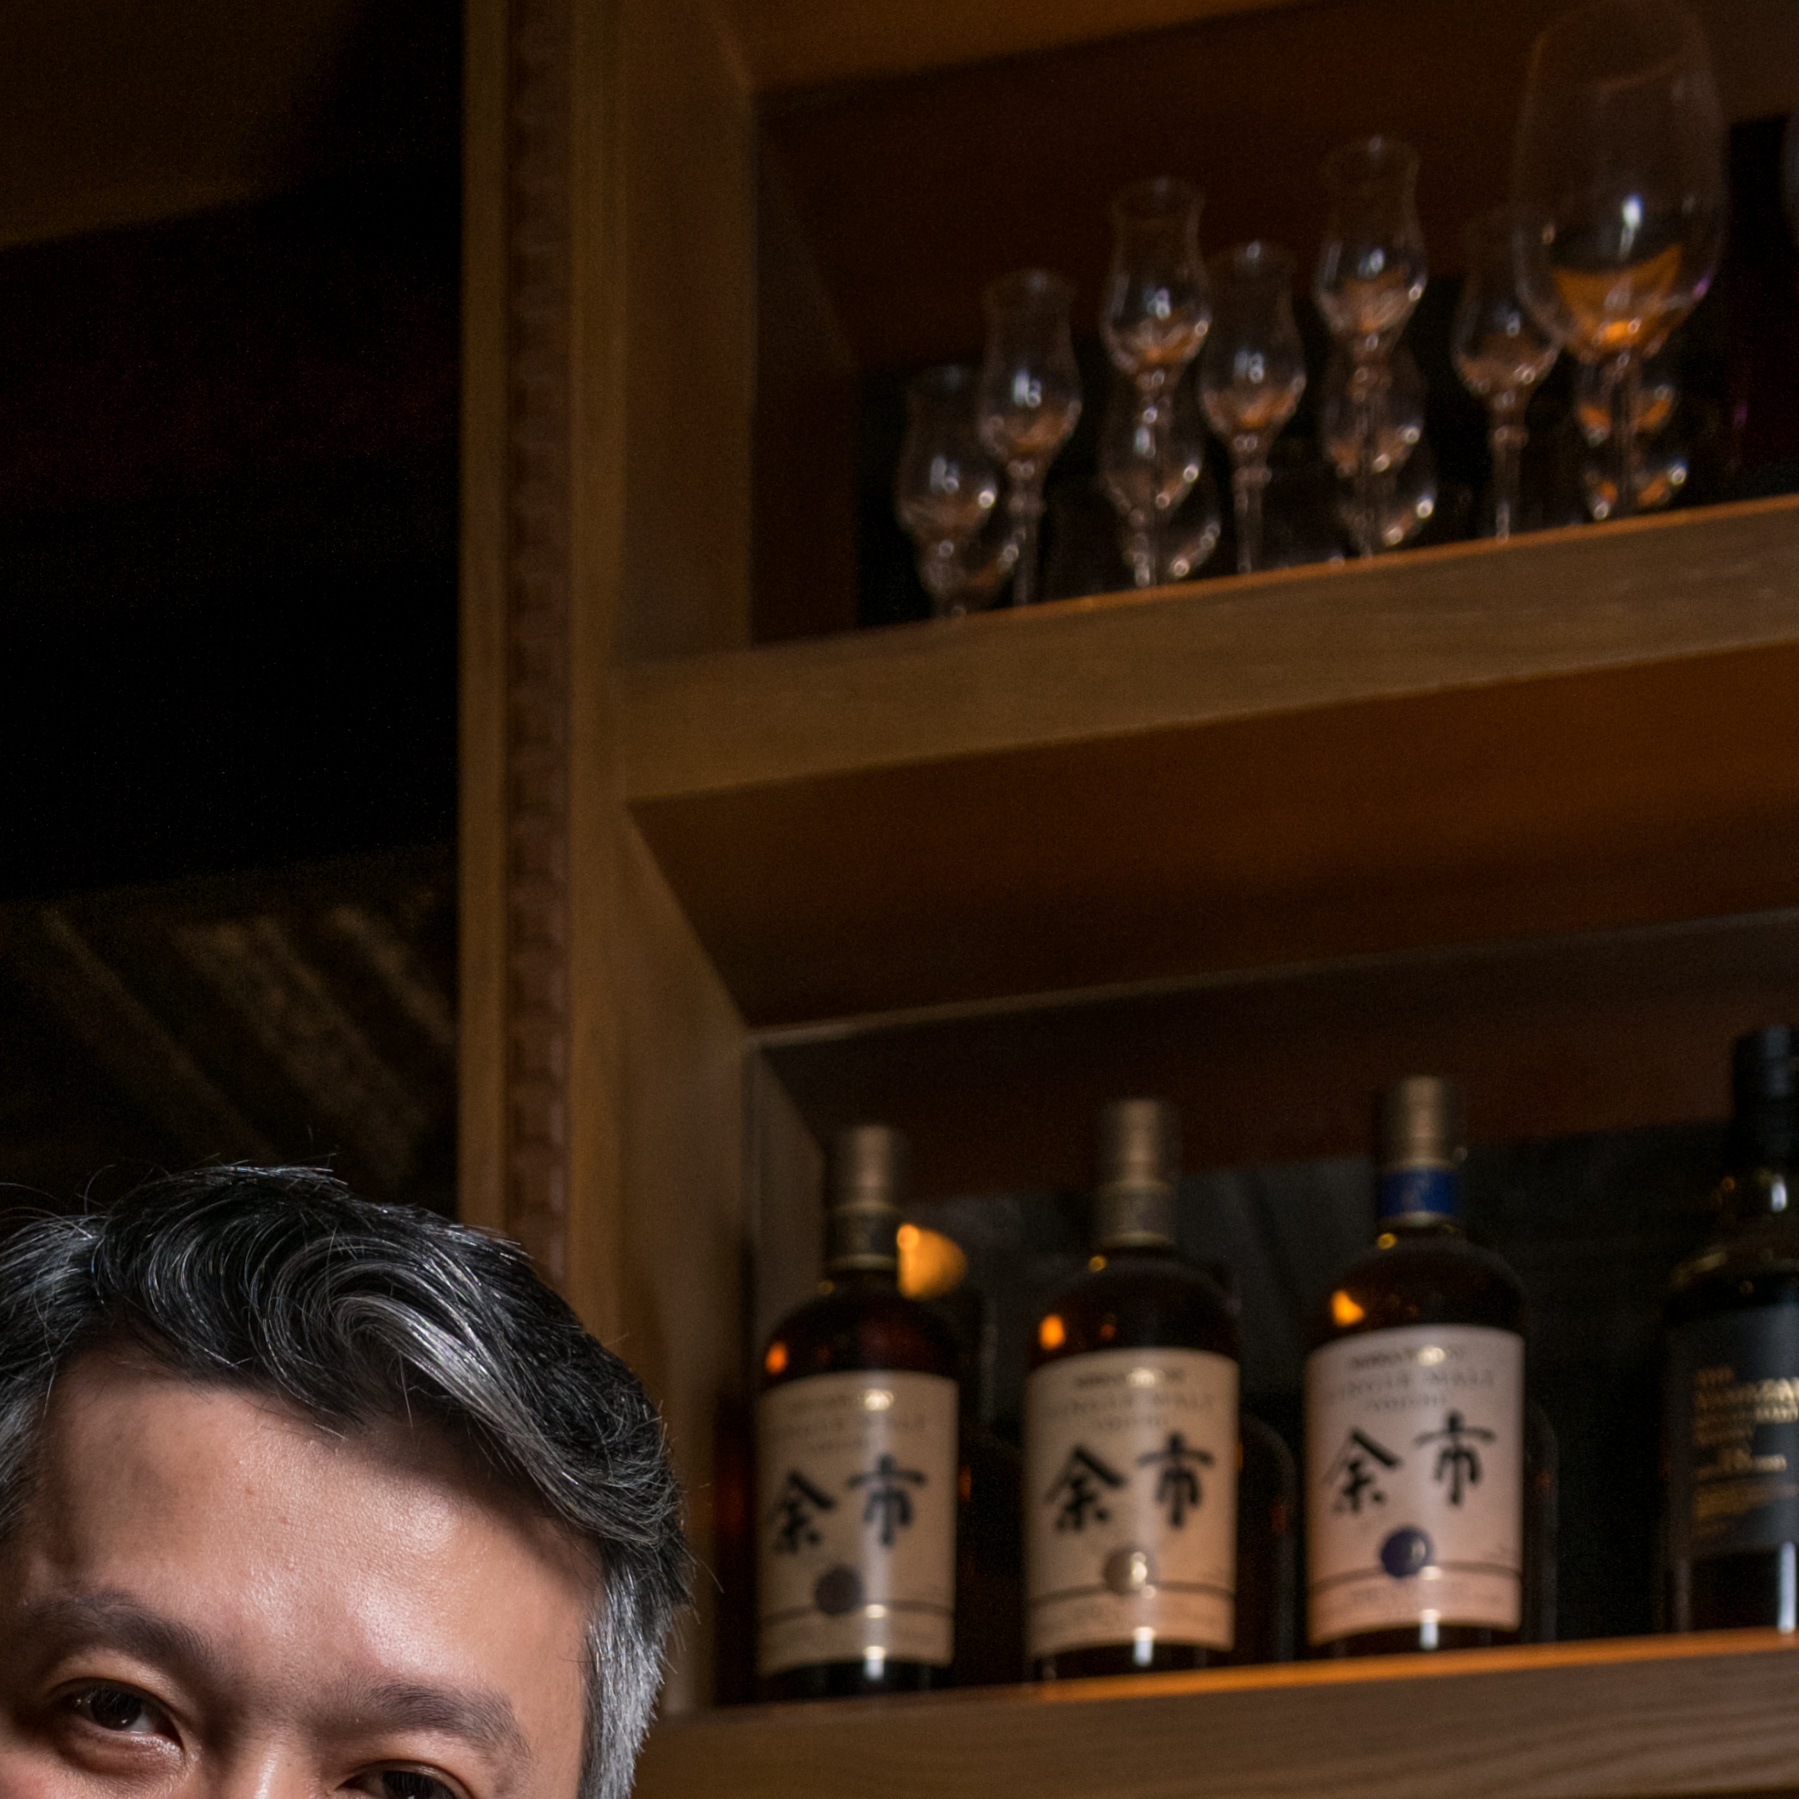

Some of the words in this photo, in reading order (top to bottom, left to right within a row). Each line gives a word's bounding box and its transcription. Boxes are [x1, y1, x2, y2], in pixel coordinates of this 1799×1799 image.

[770, 1453, 927, 1555] 余市
[1044, 1430, 1215, 1532] 余市
[1320, 1409, 1497, 1516] 余市
